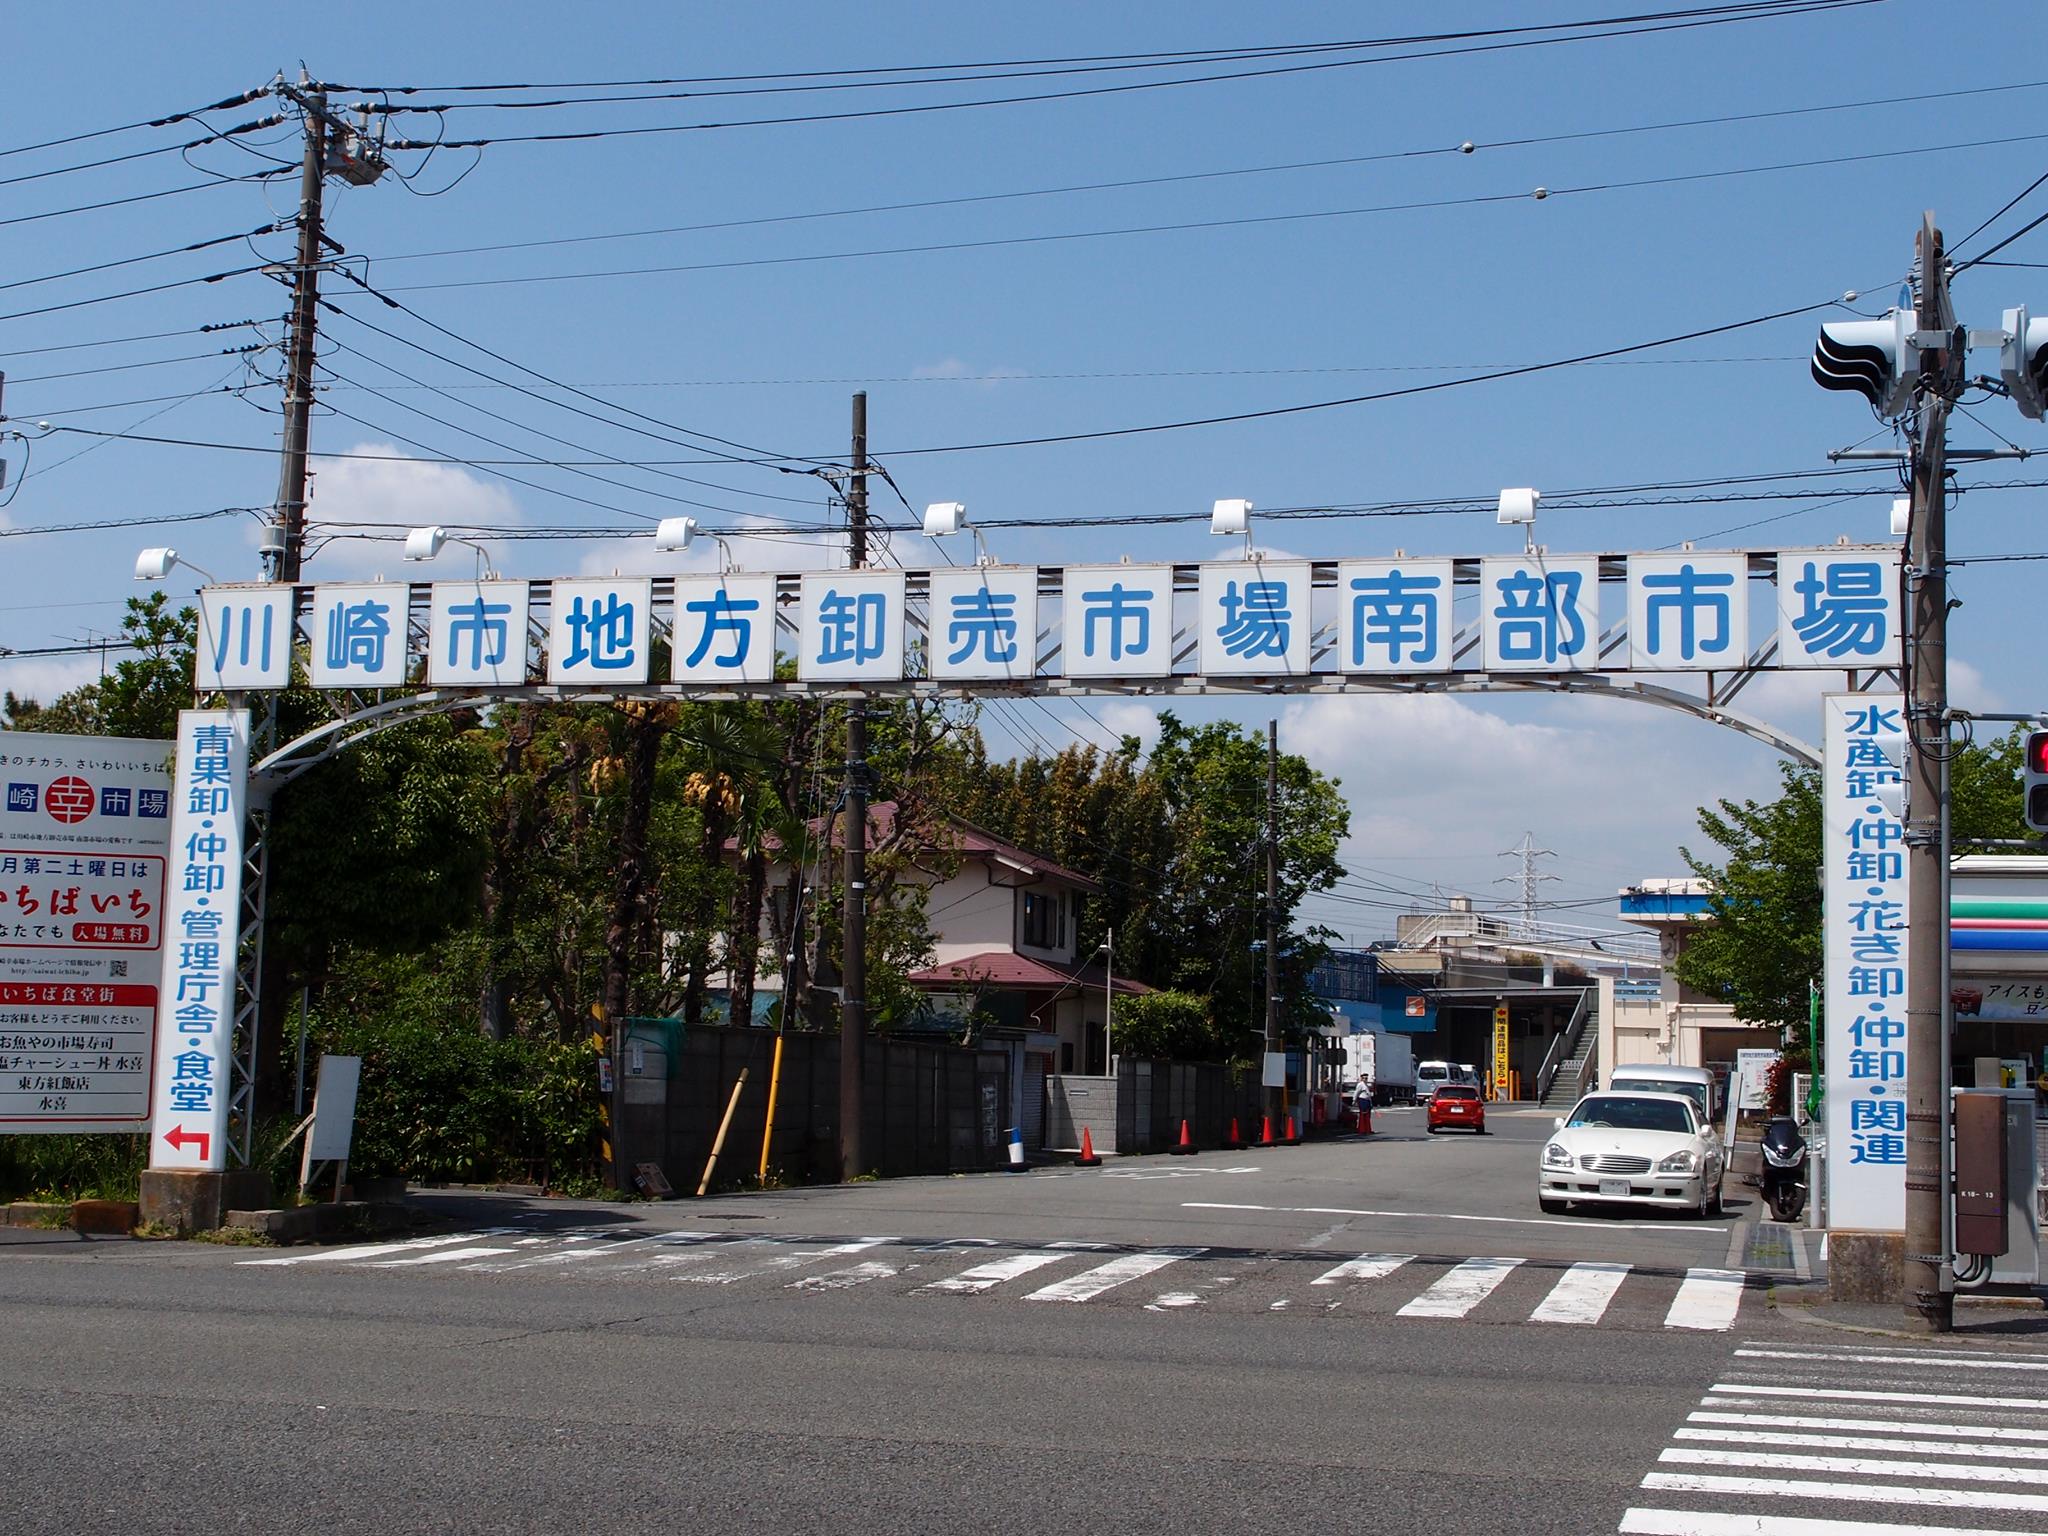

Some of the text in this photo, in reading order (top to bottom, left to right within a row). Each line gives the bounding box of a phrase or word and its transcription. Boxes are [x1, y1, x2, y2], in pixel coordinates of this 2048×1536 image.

[215, 560, 1888, 673] 川崎市地方卸売市場南部市場
[1, 857, 148, 877] 月第二土曜日は
[0, 885, 151, 919] ちばいち
[169, 725, 232, 1112] 青果卸・仲卸・管理庁舎・食堂
[76, 927, 143, 941] 入場無料
[4, 987, 114, 1002] いちば食堂街
[1987, 984, 2048, 999] アイスも
[0, 1036, 113, 1050] お魚やの市場寿司
[18, 1076, 90, 1090] 東方紅飯店
